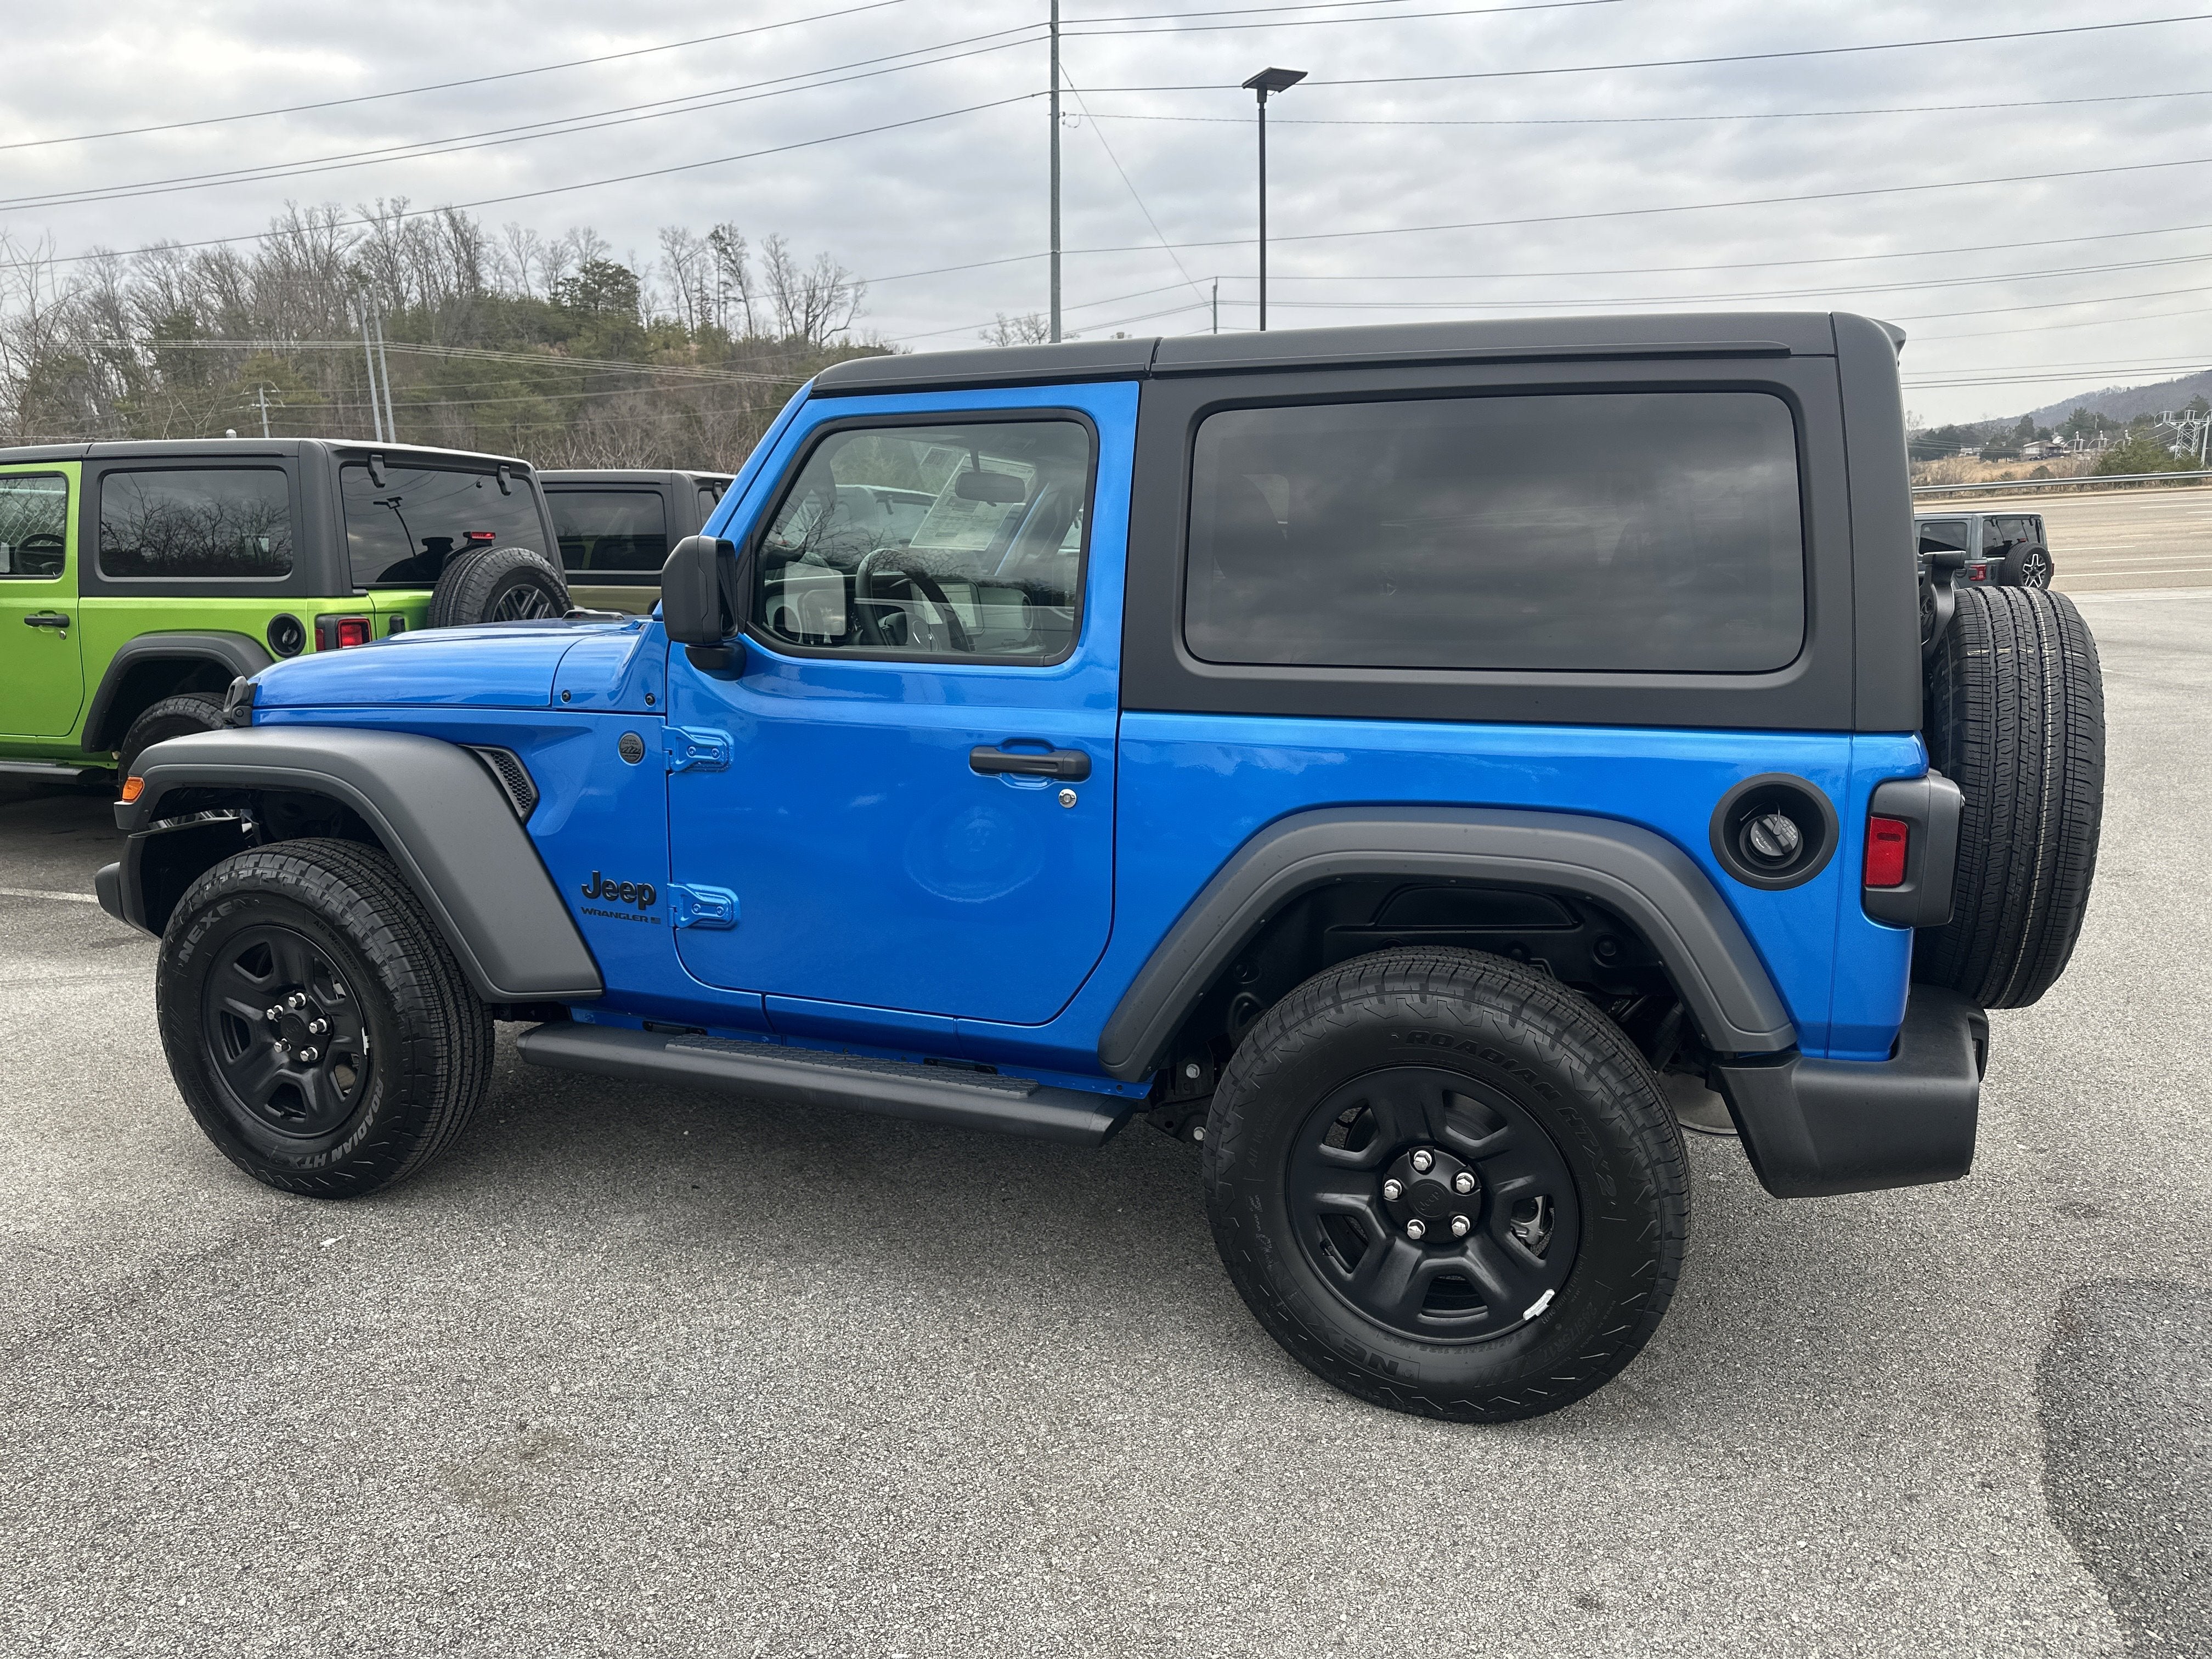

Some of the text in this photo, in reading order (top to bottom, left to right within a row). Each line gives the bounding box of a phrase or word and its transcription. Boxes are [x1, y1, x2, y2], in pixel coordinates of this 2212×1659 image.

[580, 870, 657, 910] Jeep
[580, 906, 648, 923] WRANGLER
[178, 898, 248, 963] NEXEN
[329, 1076, 385, 1163] ROADIAN
[1402, 1030, 1618, 1198] ROADIAN HTX2
[1420, 1192, 1440, 1210] Jeep
[1264, 1262, 1399, 1378] NEXEN
